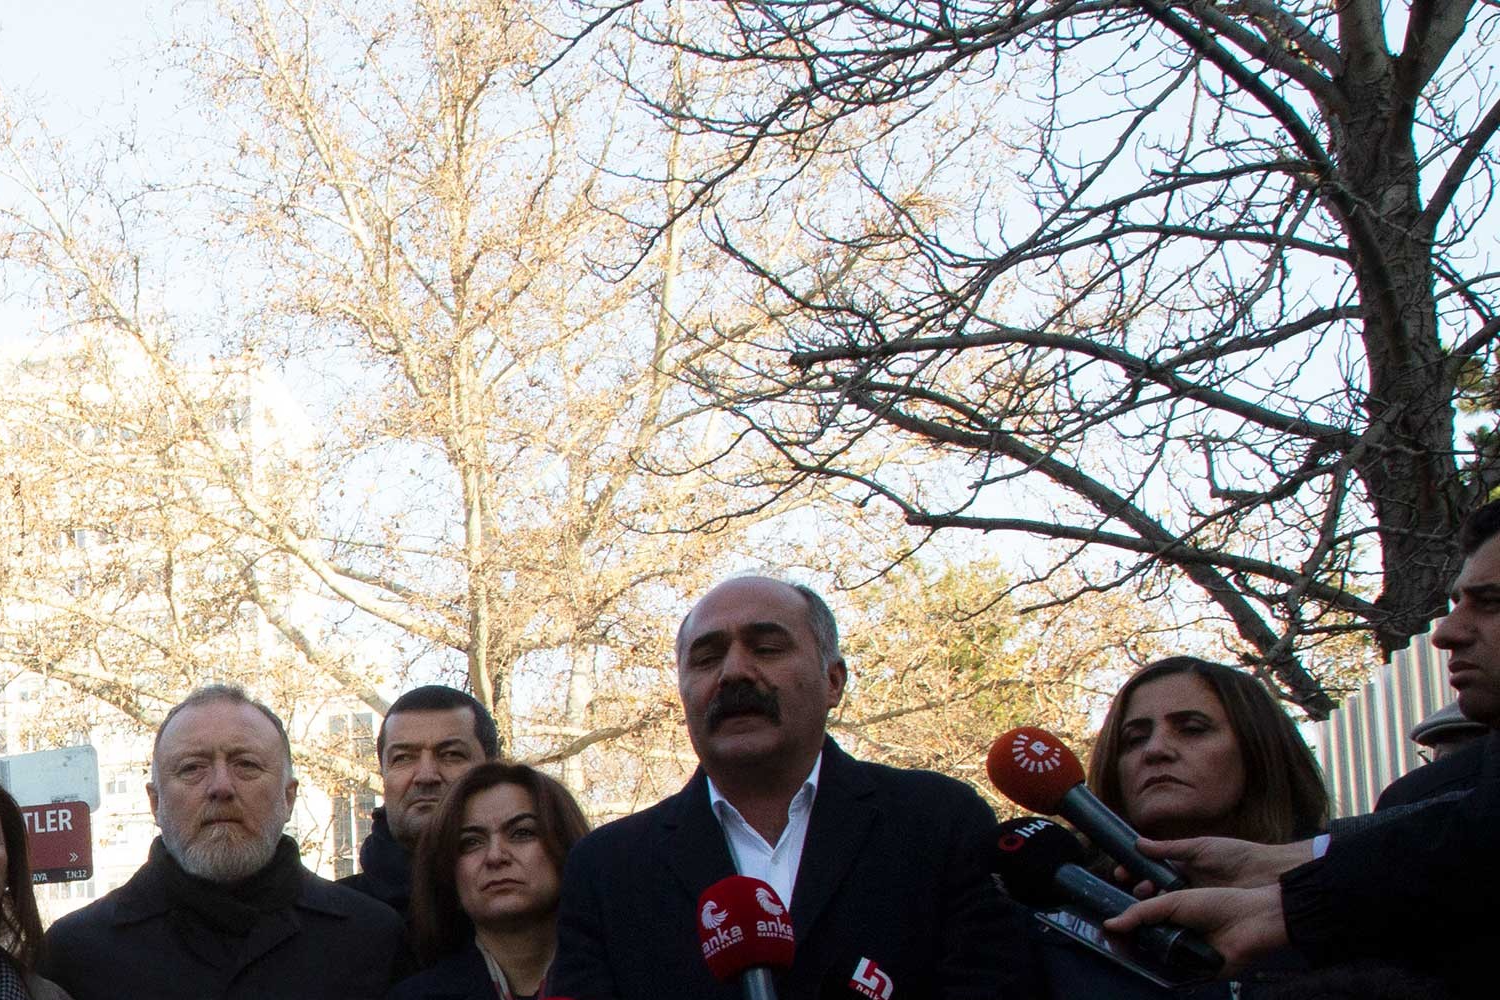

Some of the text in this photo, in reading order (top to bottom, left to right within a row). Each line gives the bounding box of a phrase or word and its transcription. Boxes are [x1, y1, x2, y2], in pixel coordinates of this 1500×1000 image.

[22, 808, 73, 834] TLER
[33, 873, 48, 882] AYA
[756, 916, 794, 936] anka
[701, 925, 743, 955] anka
